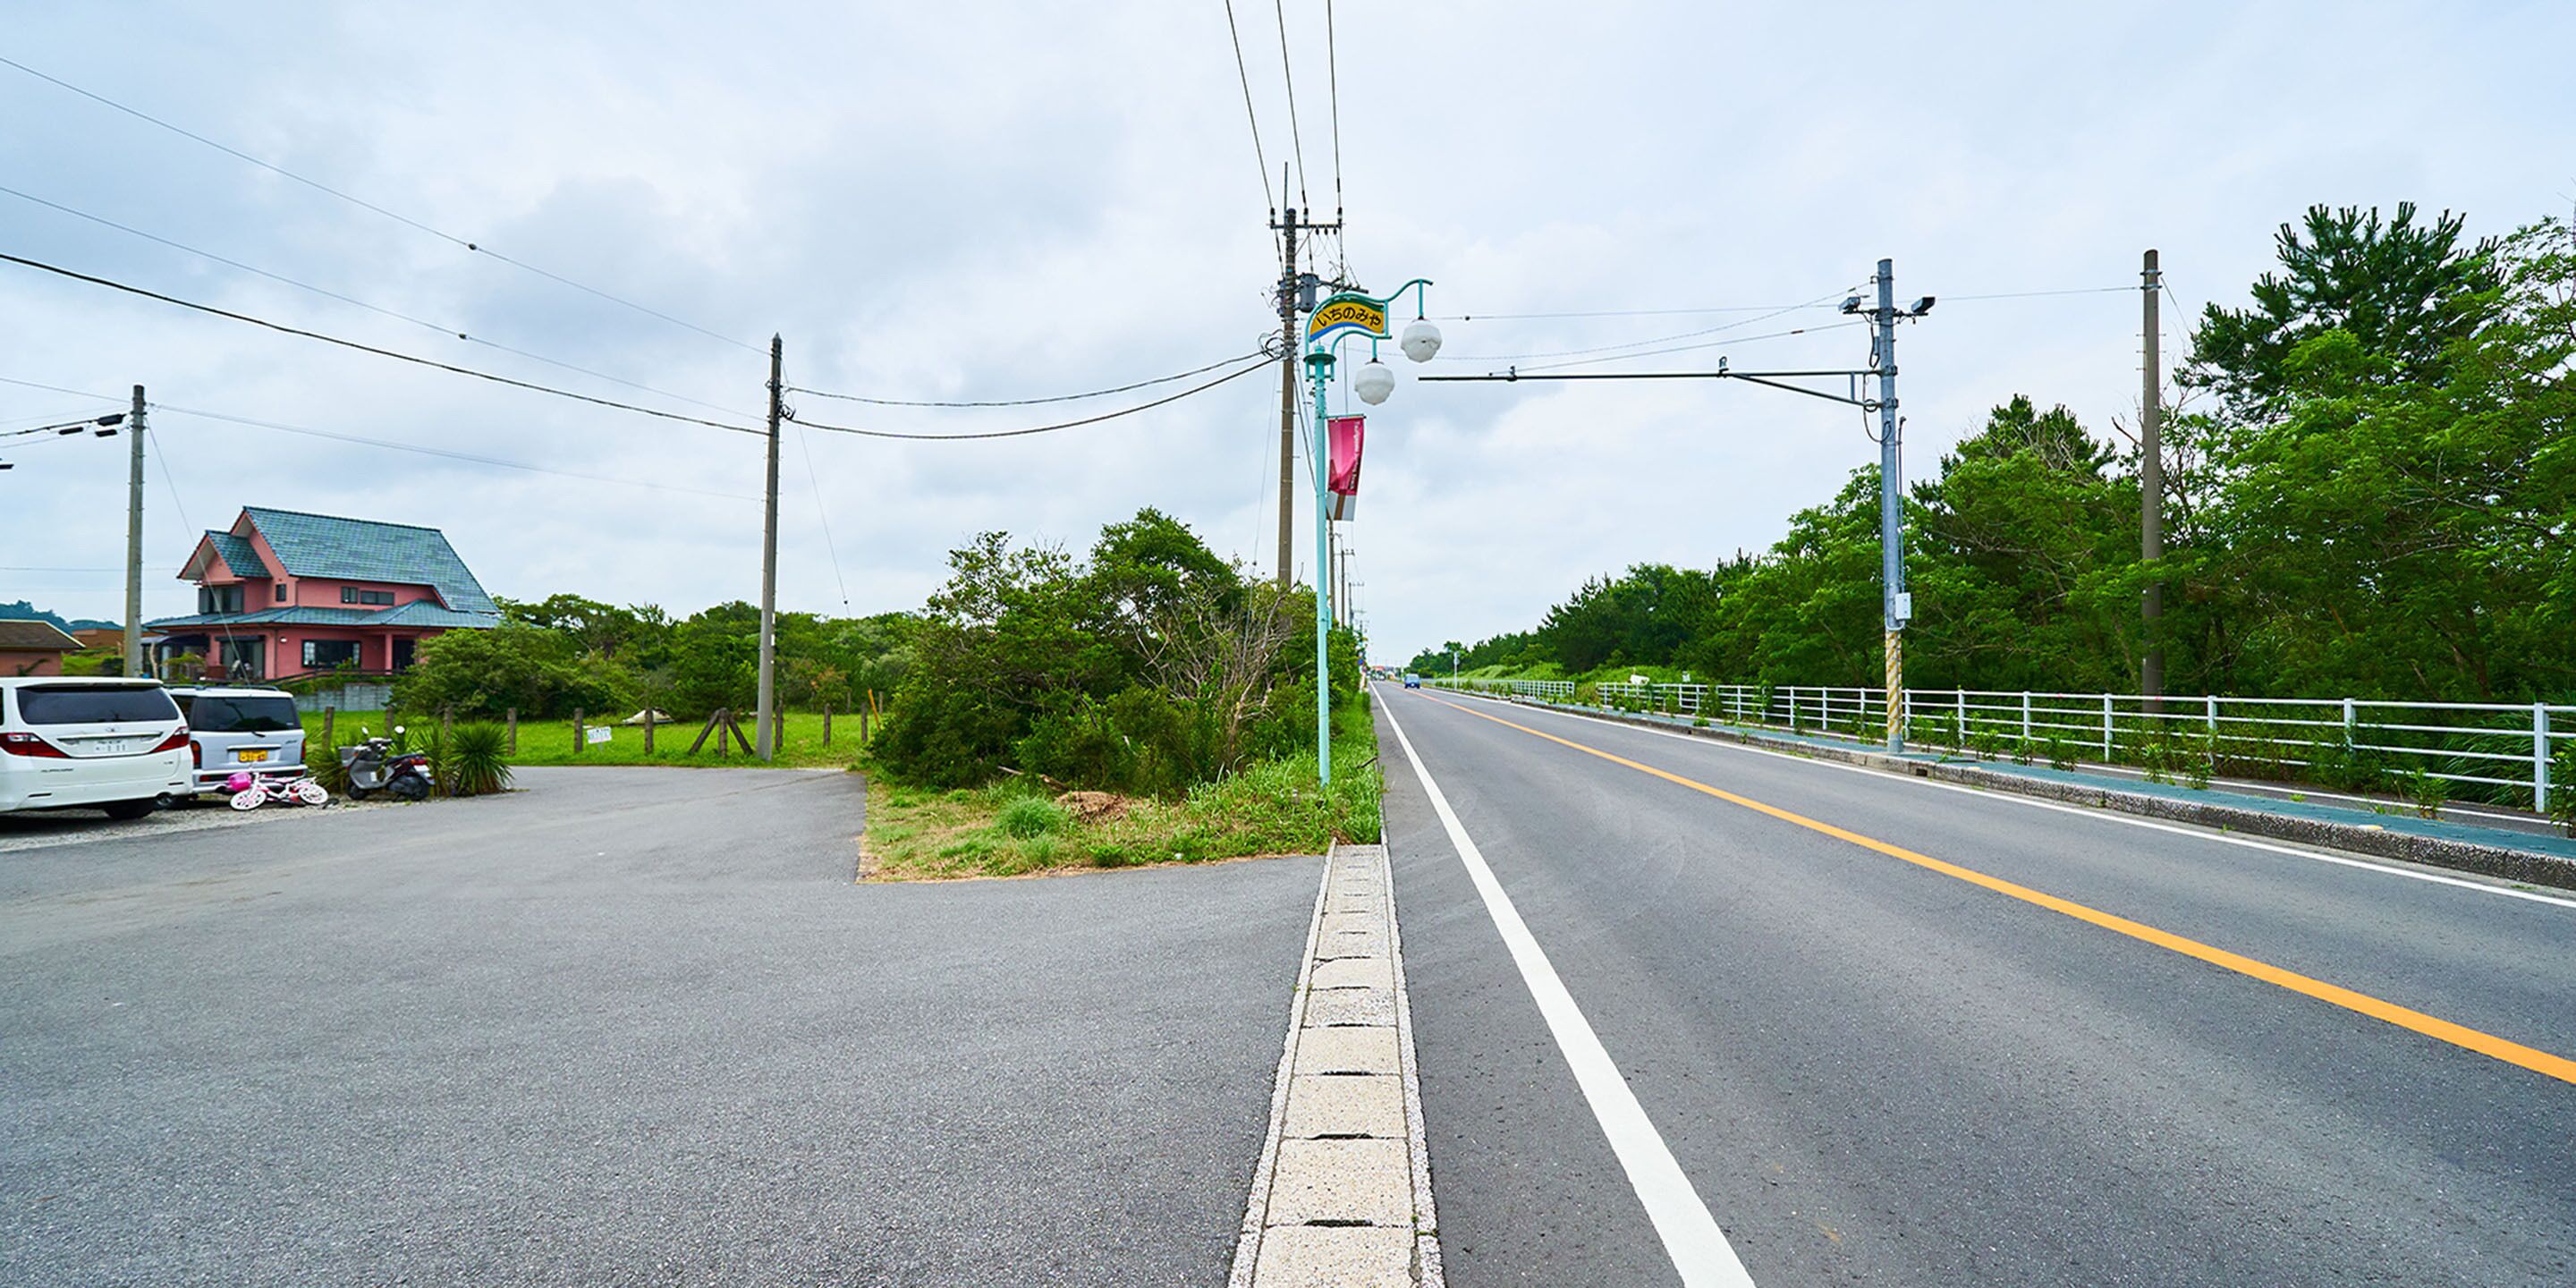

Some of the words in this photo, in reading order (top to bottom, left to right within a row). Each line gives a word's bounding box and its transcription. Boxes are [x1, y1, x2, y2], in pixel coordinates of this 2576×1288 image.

[1316, 307, 1382, 327] いちのみや
